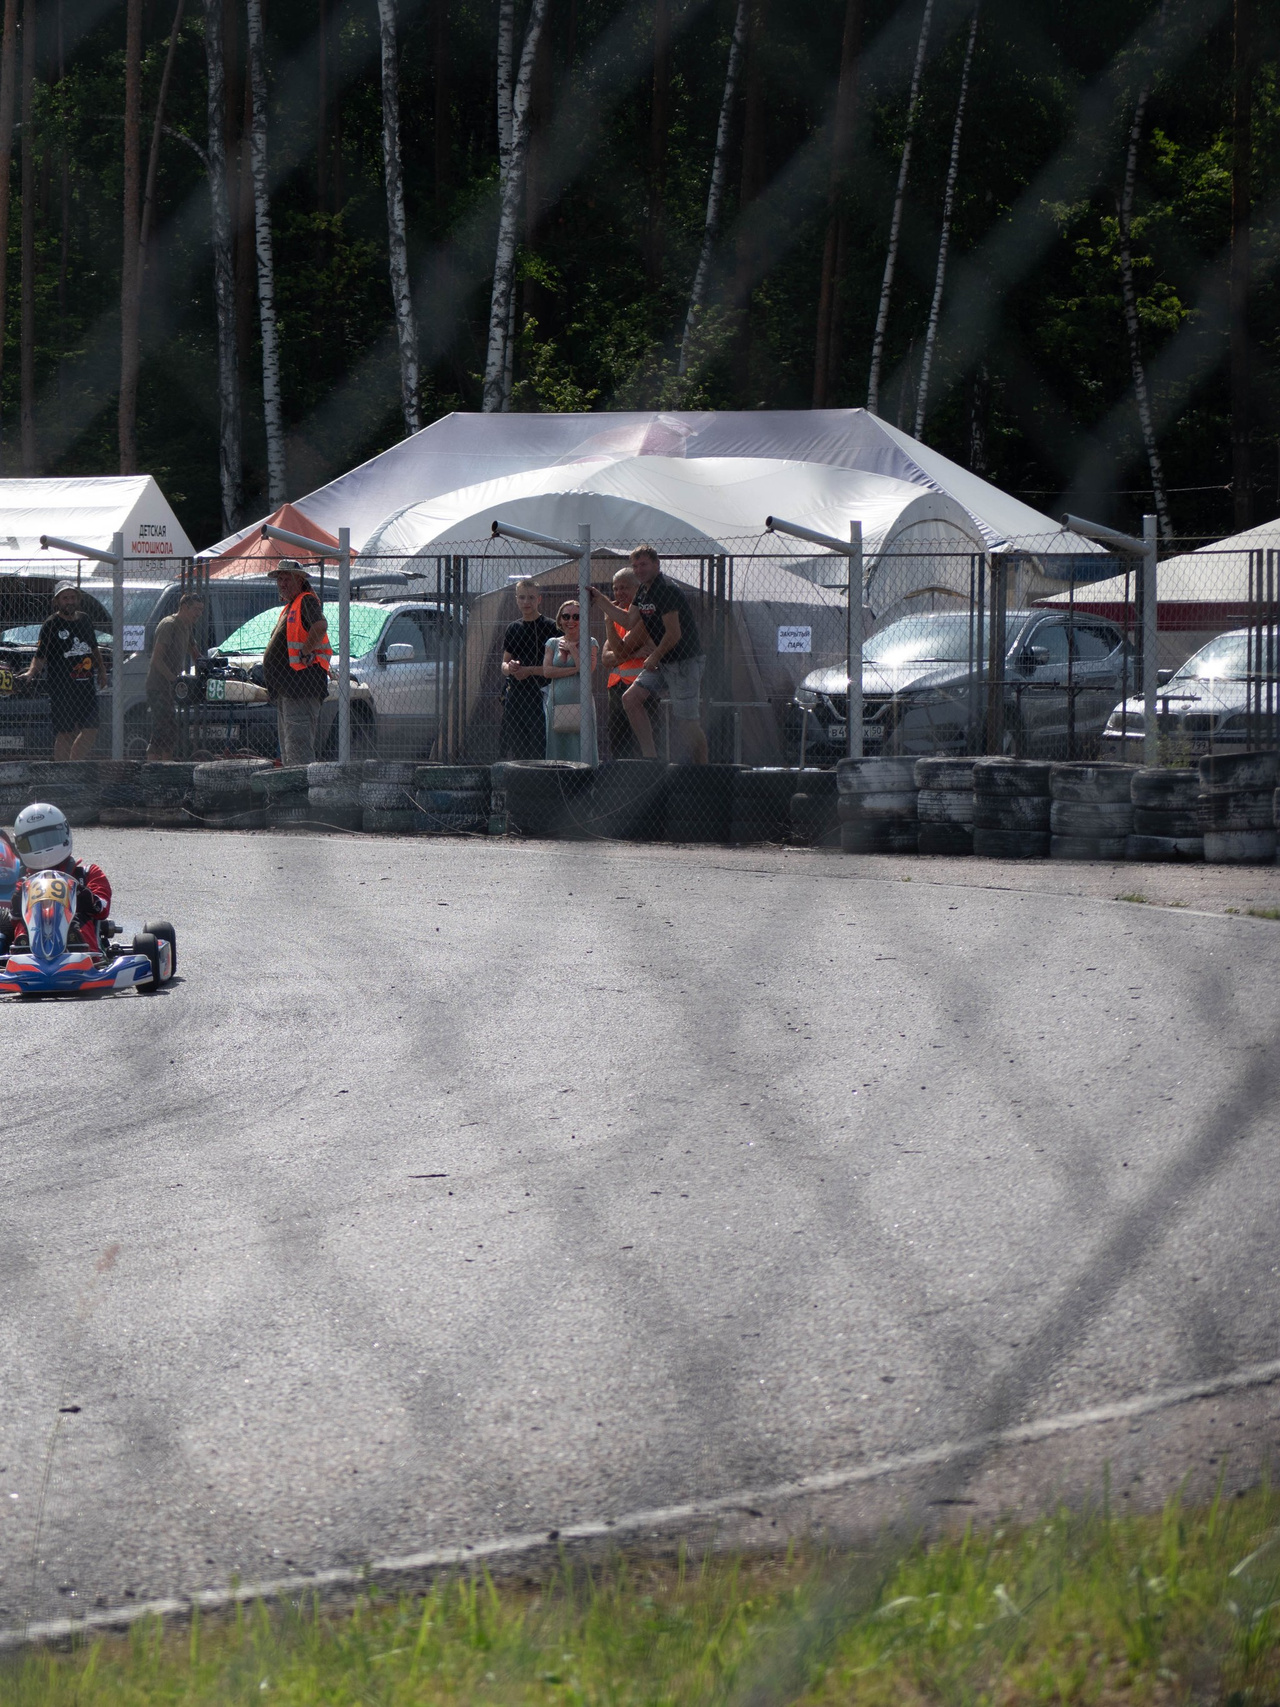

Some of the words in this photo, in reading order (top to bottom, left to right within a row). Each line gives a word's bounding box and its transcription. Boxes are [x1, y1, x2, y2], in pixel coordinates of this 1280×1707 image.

[139, 524, 167, 538] ДЕТСКАЯ
[131, 540, 174, 555] МОТОШКОЛА
[779, 630, 811, 638] ЗАКРЫТЫЙ
[787, 641, 805, 649] ПАРК
[208, 680, 225, 700] 96
[31, 880, 66, 900] 39
